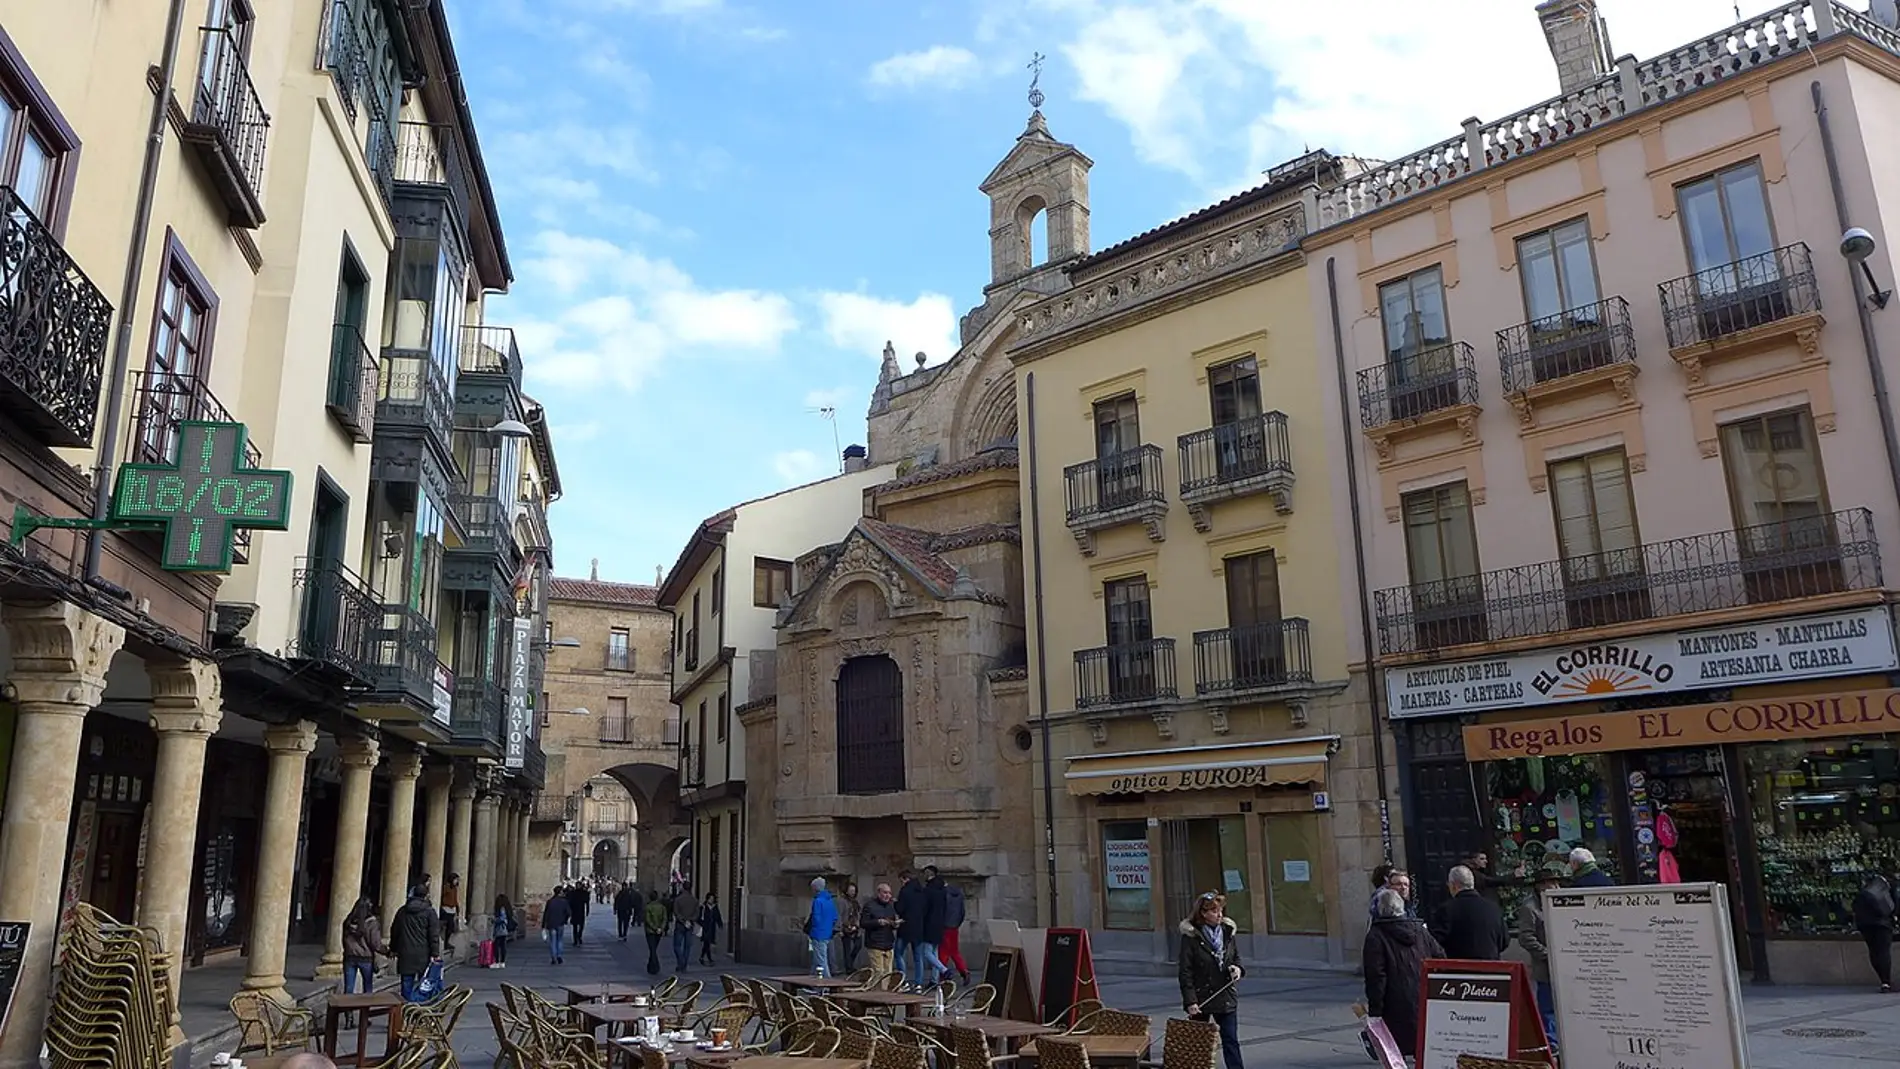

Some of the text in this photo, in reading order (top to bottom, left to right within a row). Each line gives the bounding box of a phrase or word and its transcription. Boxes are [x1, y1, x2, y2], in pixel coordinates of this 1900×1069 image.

[130, 474, 274, 516] 18/02
[1678, 631, 1758, 657] MANTONES
[1775, 618, 1868, 646] MANTILLAS
[513, 630, 527, 688] PLAZA
[1406, 661, 1512, 689] ARTICULOS DE PIEL
[1531, 645, 1674, 695] EL CORRILLO
[1700, 646, 1853, 679] ARTESANIA CHARRA
[1400, 689, 1451, 710] MALETAS
[1464, 682, 1523, 703] CARTERAS
[510, 696, 526, 755] MAYOR
[1488, 718, 1603, 756] Regalos
[1637, 712, 1683, 740] EL
[1178, 765, 1268, 787] EUROPA
[1115, 874, 1146, 885] TOTAL
[1440, 981, 1498, 999] La Platea
[1627, 1037, 1656, 1056] 11€
